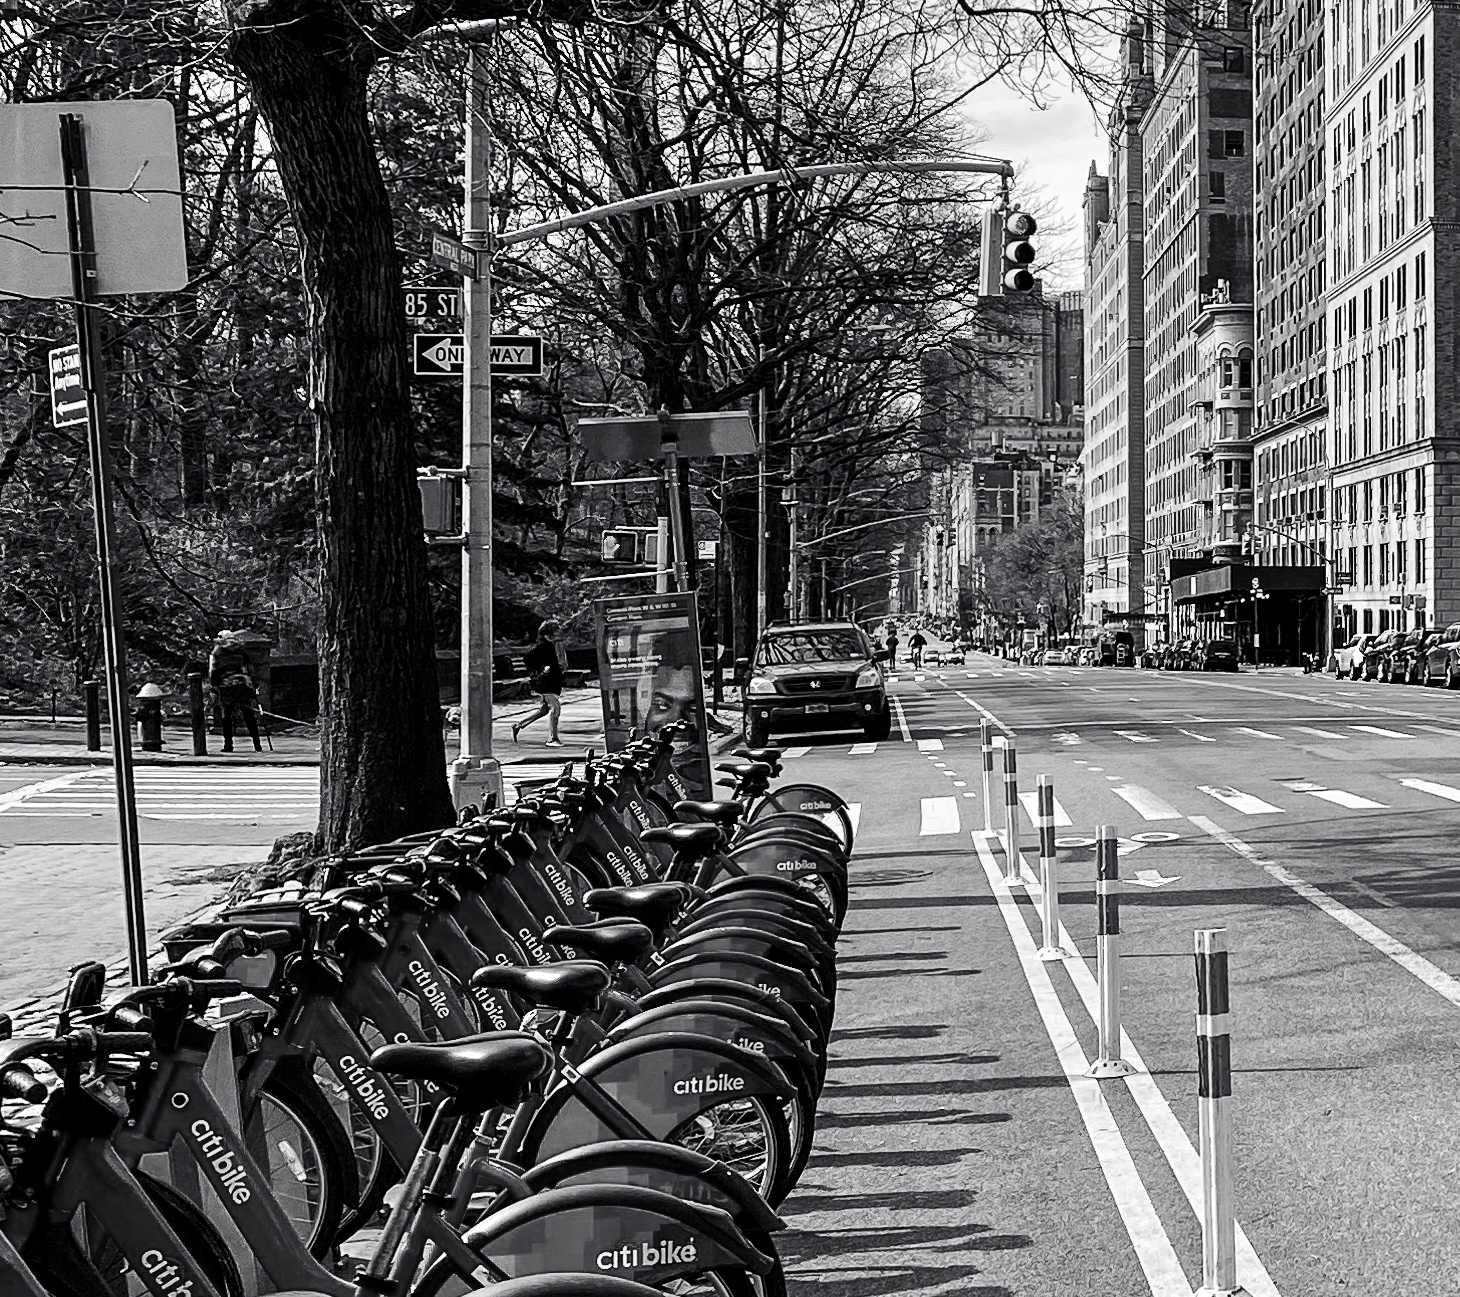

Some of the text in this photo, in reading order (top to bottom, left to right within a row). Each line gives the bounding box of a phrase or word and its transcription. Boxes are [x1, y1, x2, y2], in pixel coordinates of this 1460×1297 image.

[405, 293, 458, 316] 85 ST
[435, 347, 525, 363] ON WAY
